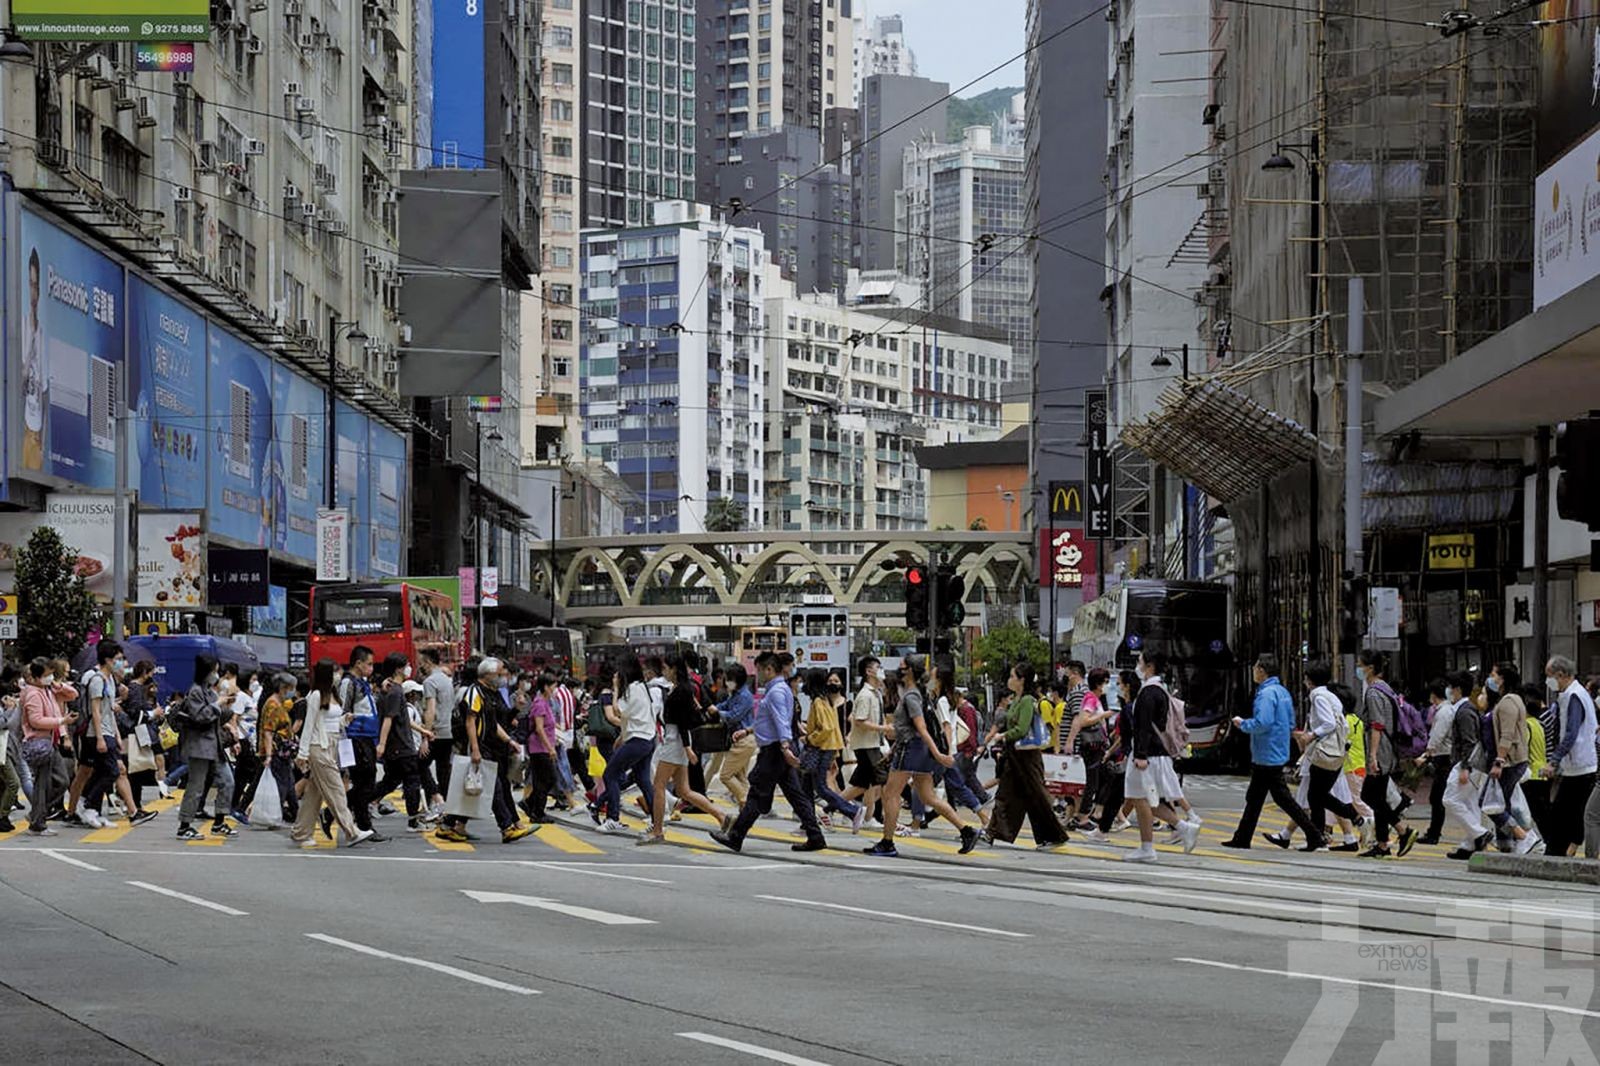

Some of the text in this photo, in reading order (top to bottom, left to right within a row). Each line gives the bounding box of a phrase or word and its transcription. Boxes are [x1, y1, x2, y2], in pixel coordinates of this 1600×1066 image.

[17, 23, 205, 35] www.innoutstorage.com 9275 8858
[48, 265, 88, 313] Panasonic
[1430, 543, 1474, 559] TOTO
